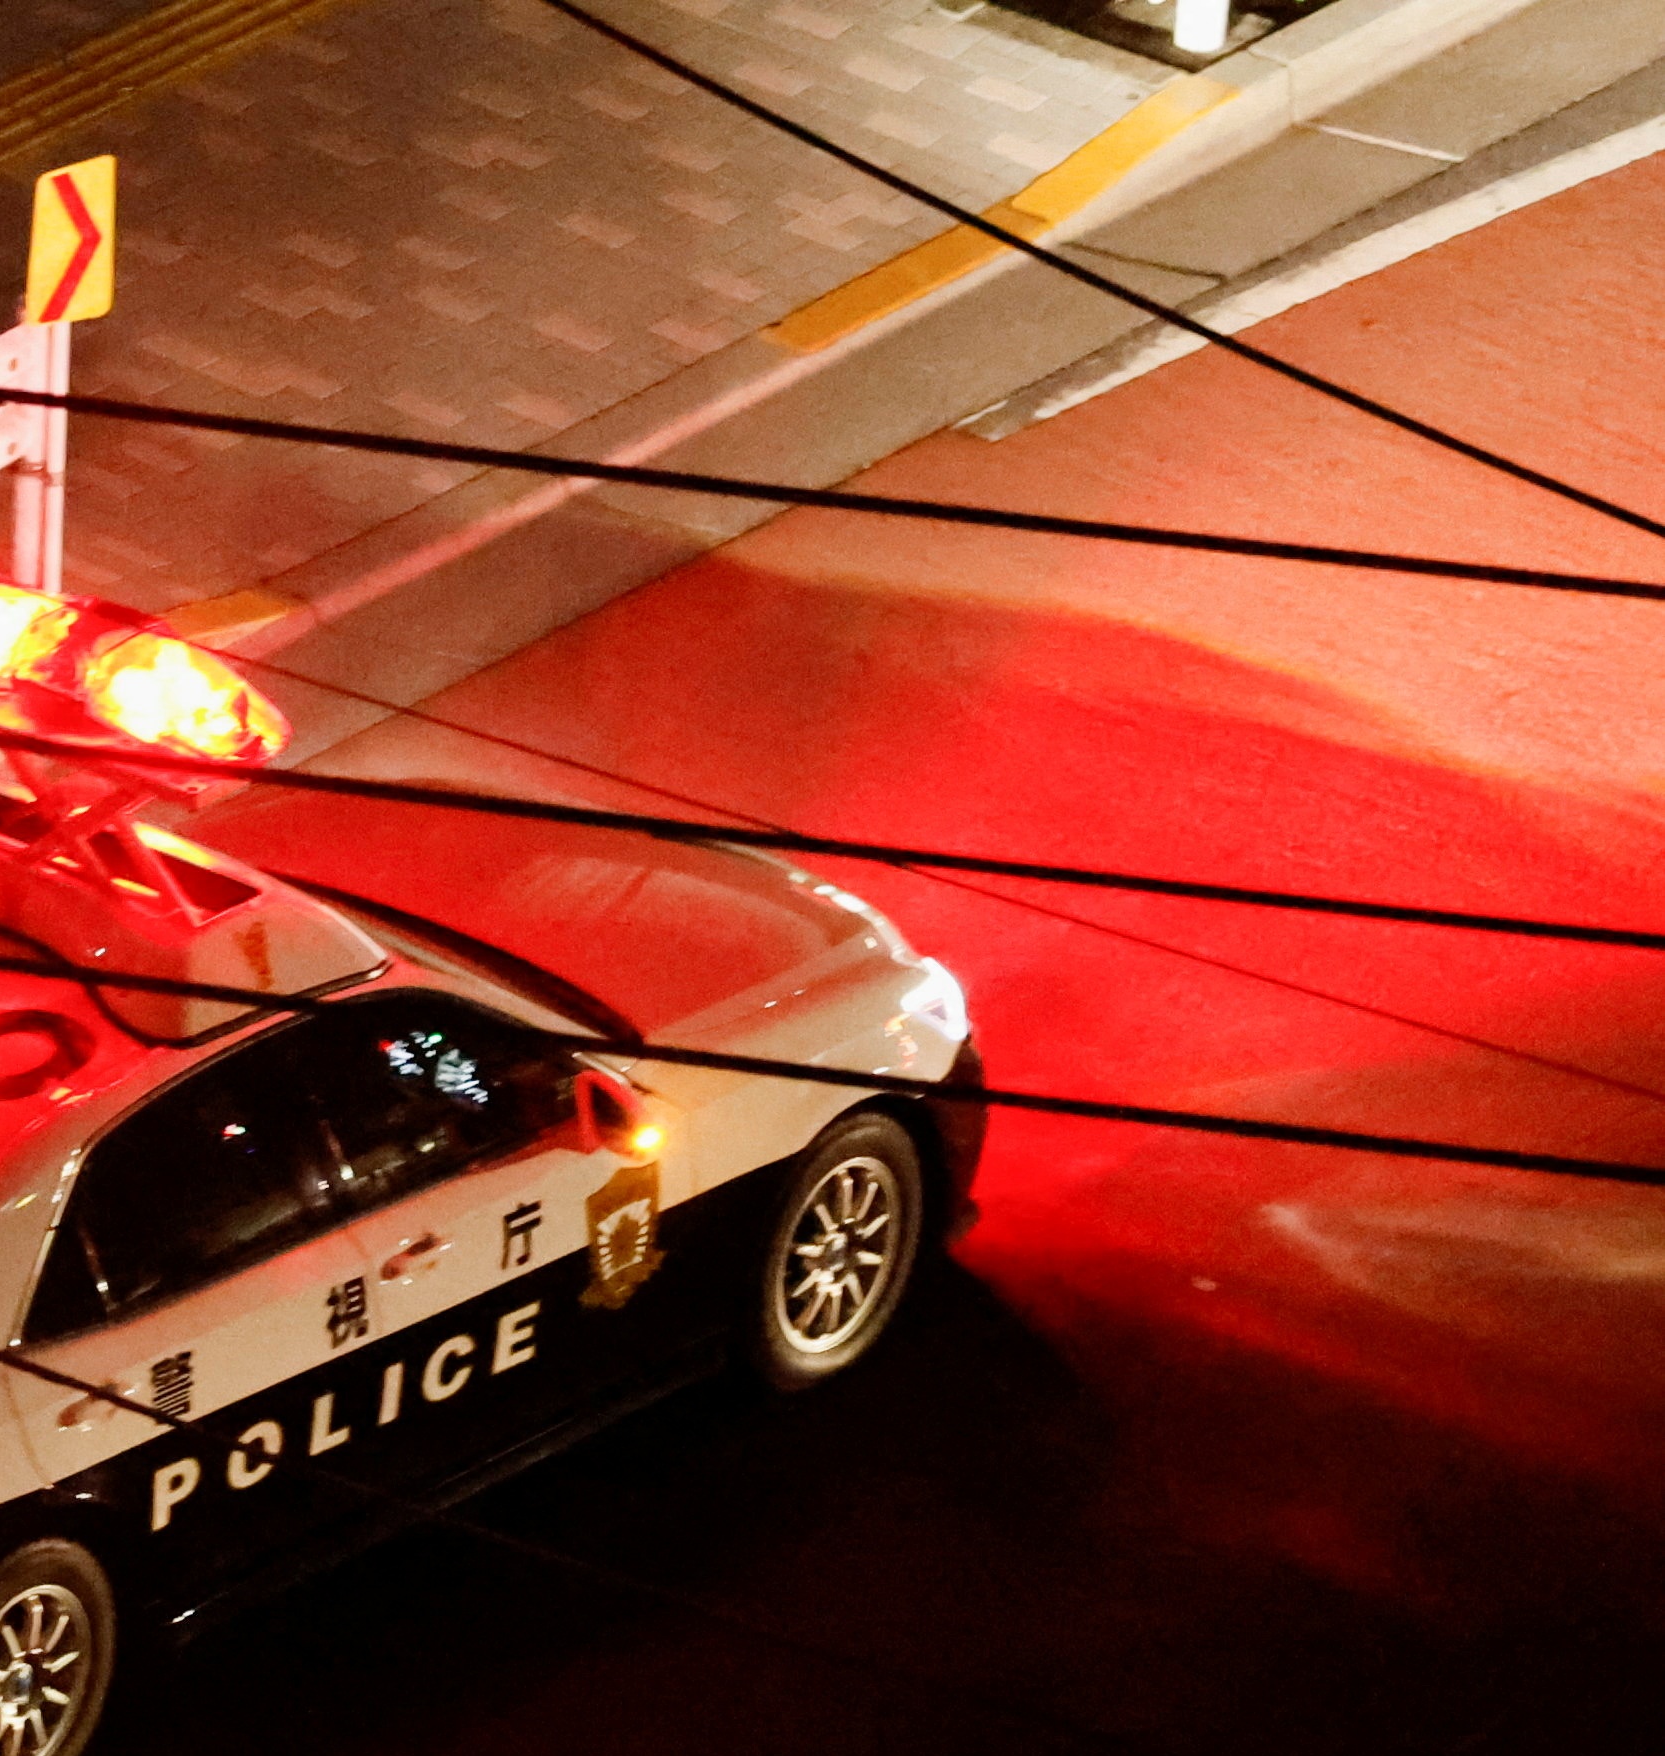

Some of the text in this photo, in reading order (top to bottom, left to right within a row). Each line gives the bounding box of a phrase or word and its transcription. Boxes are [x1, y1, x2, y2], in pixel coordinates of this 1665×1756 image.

[150, 1199, 543, 1421] 警視庁
[150, 1300, 542, 1533] POLICE
